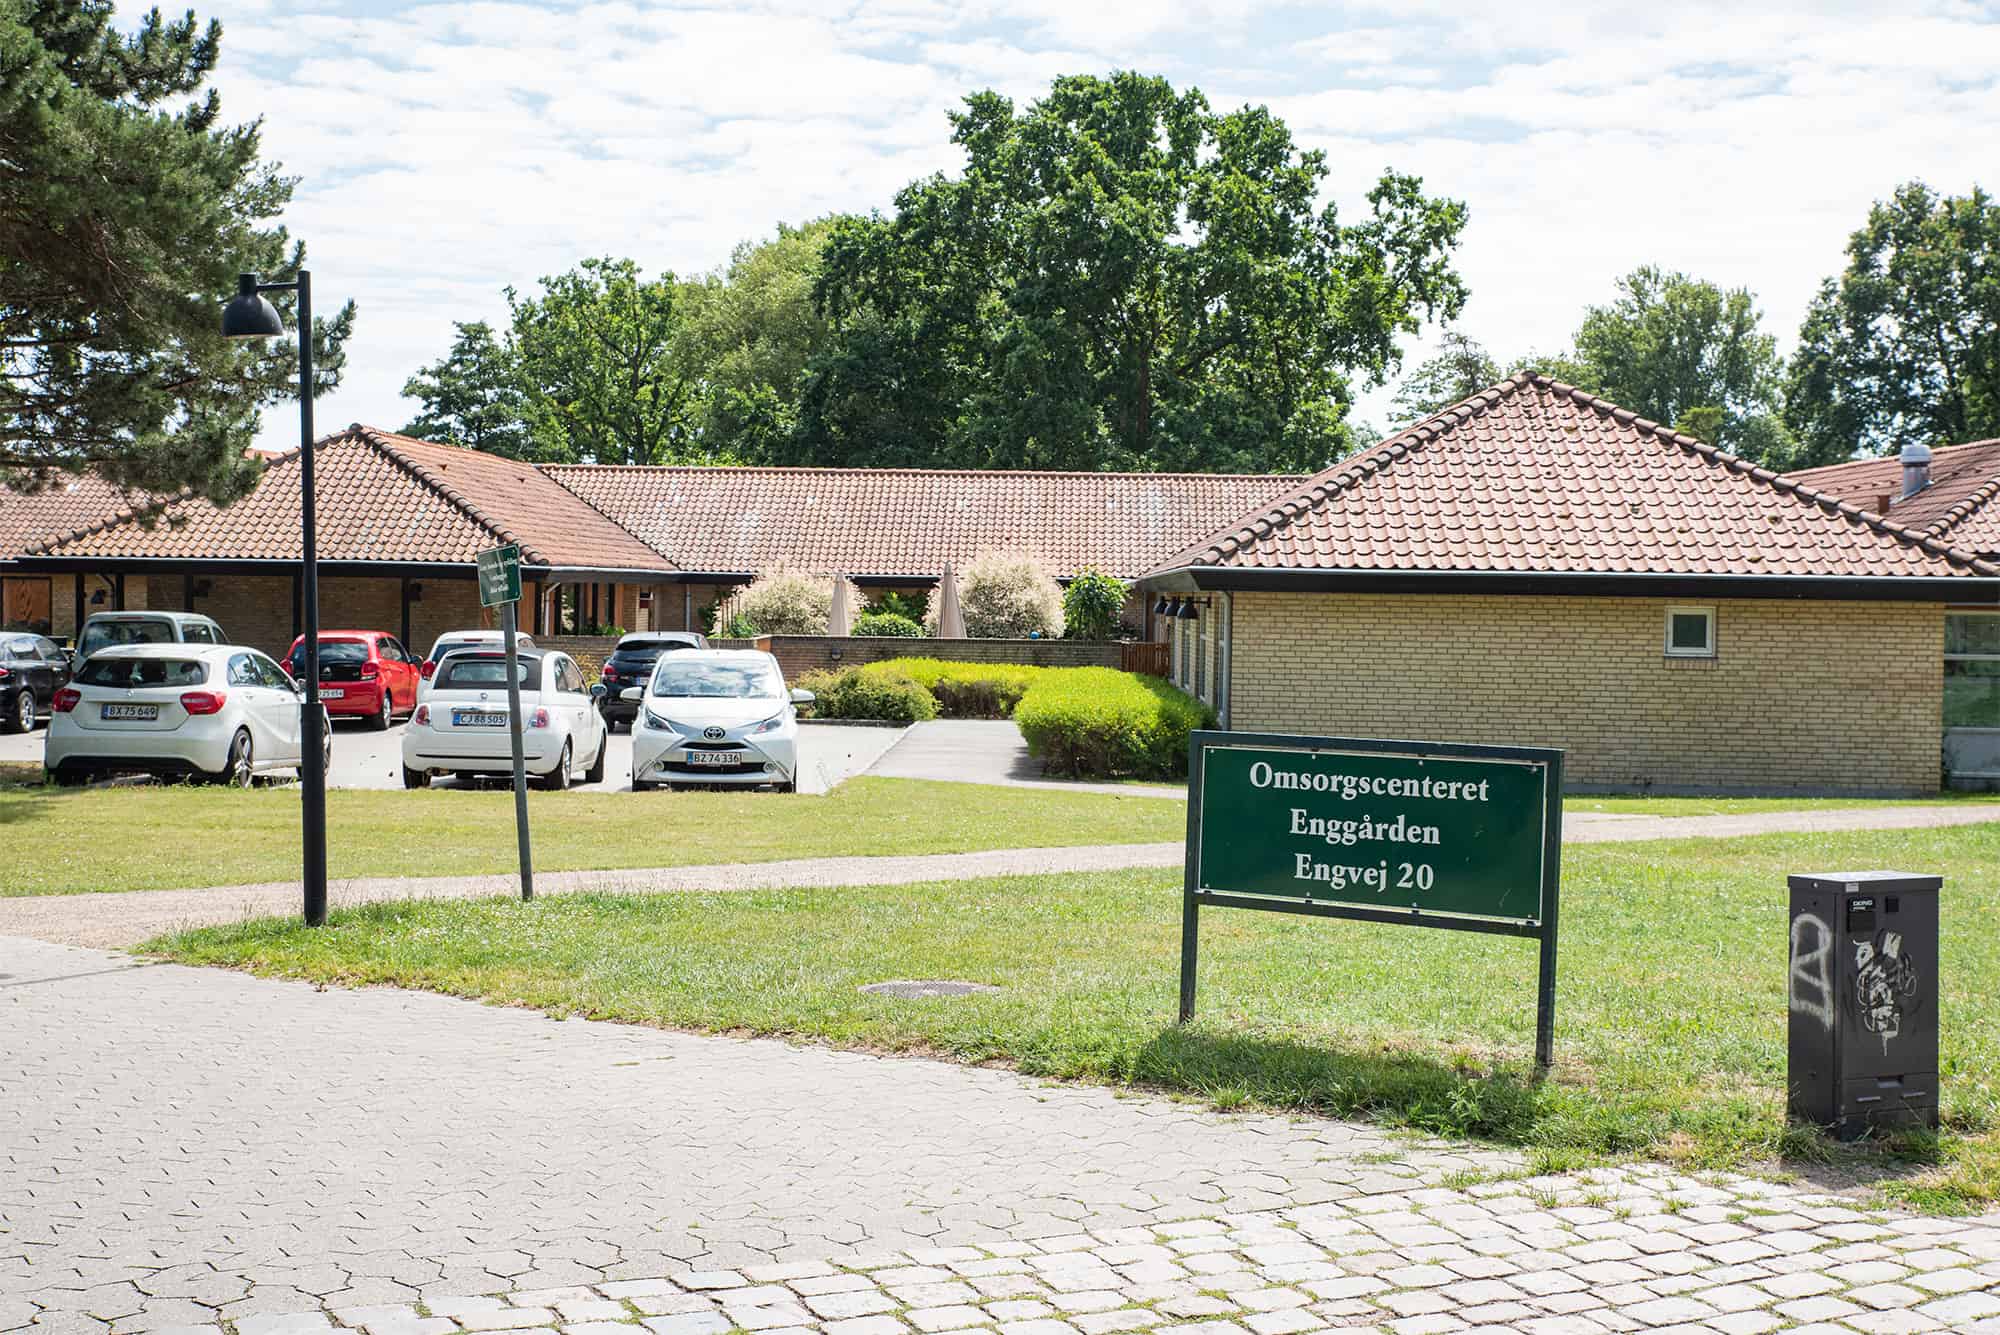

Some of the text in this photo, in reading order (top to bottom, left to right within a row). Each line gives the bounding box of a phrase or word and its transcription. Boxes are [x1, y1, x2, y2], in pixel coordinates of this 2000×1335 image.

[110, 706, 156, 716] BX 75 649
[461, 715, 472, 724] CJ
[488, 715, 504, 723] 505
[695, 754, 740, 763] BZ 74 336
[1250, 761, 1489, 801] Omsorgscenteret
[1290, 809, 1440, 845] Enggården
[1294, 854, 1433, 892] Engvej 20
